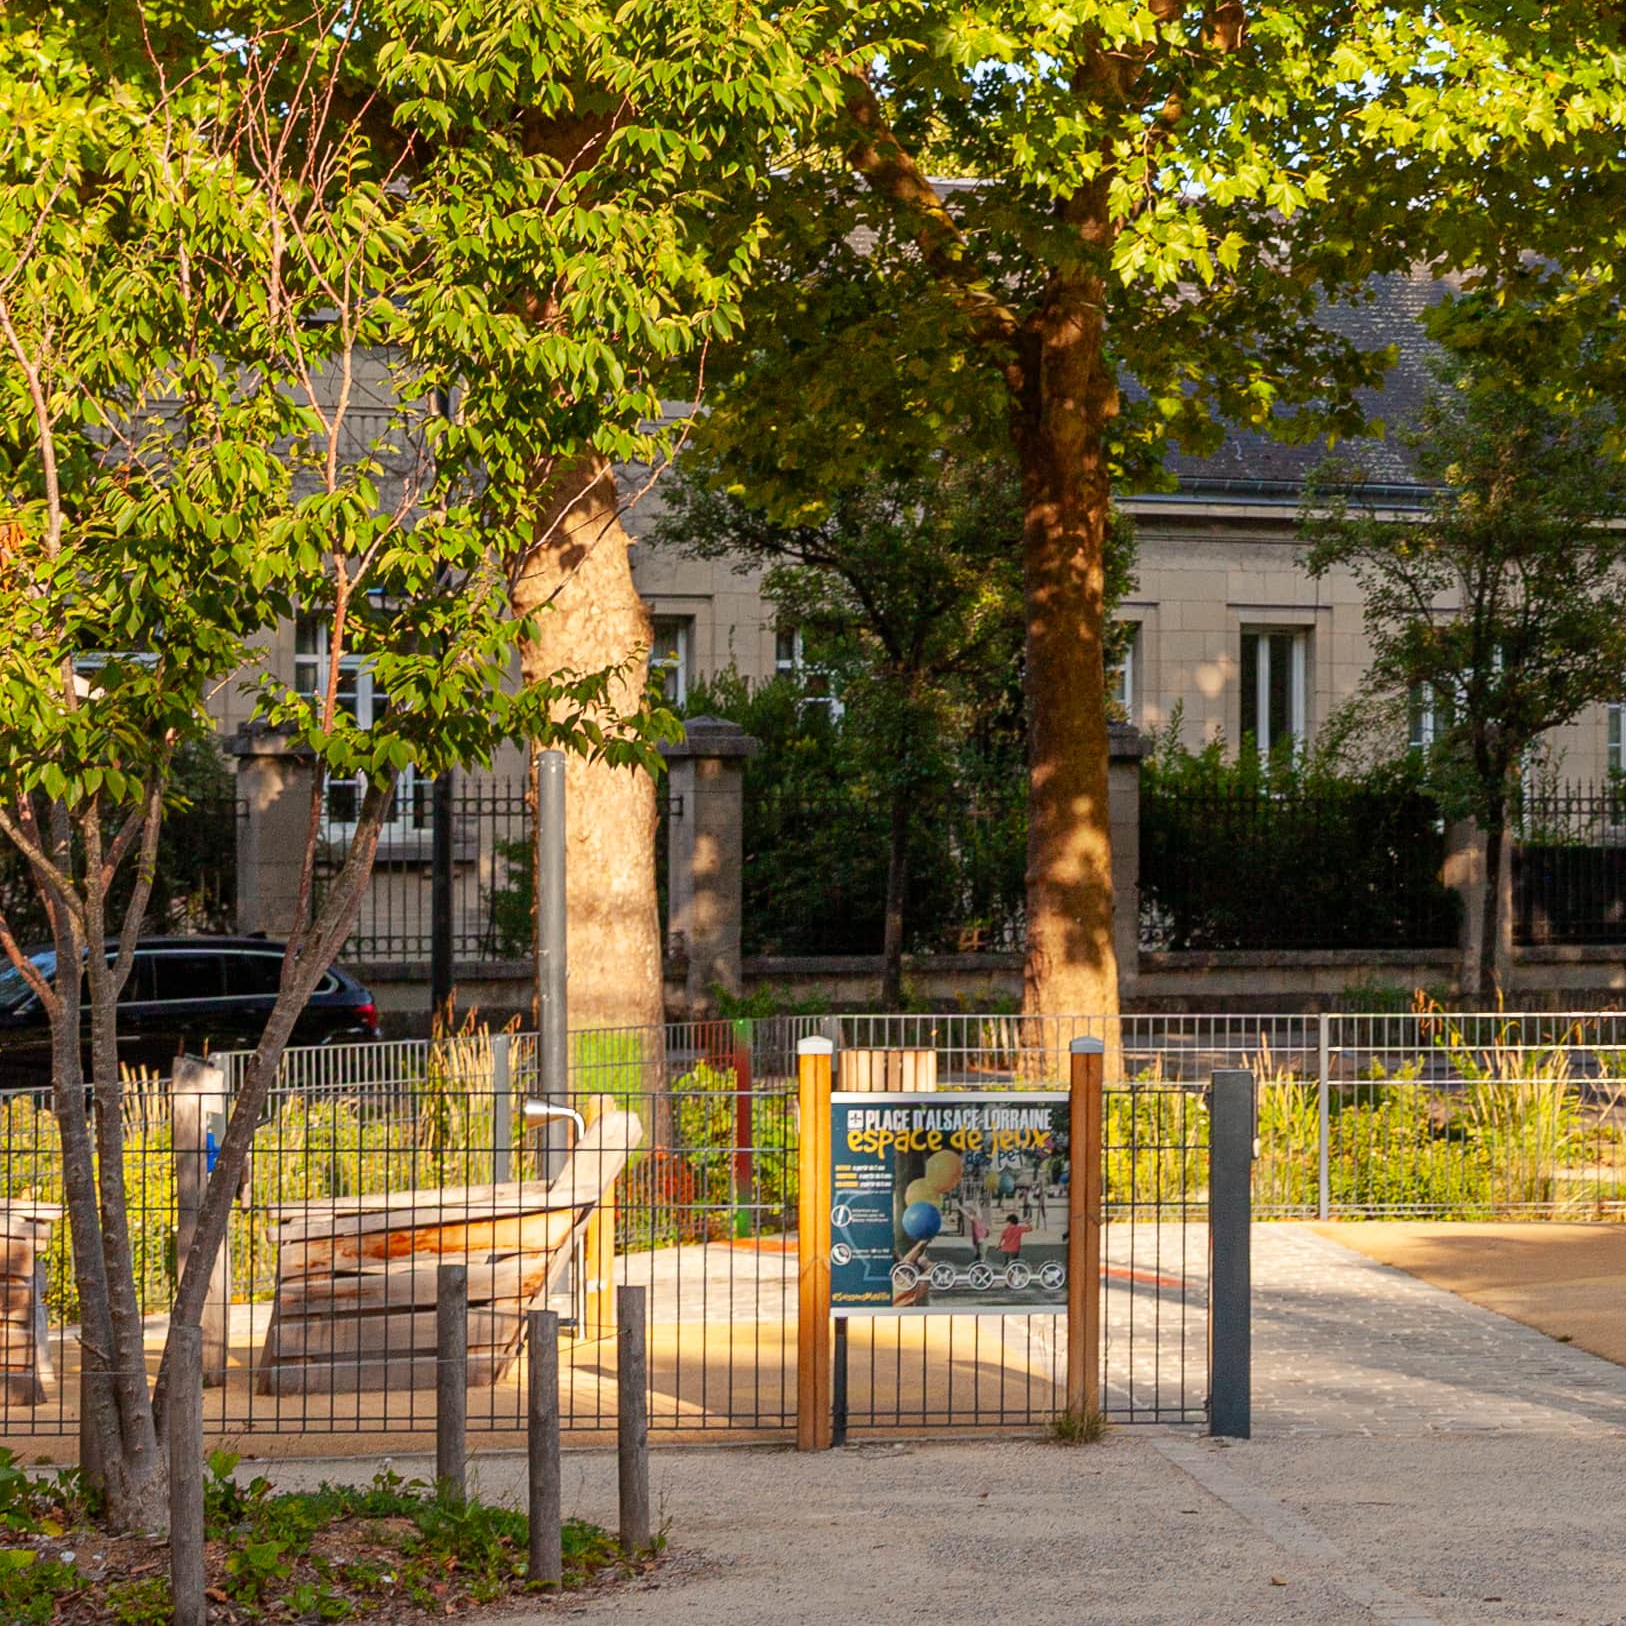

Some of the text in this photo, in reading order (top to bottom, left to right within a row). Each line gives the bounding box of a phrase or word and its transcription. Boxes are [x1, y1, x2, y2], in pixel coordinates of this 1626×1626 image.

[865, 1108, 1052, 1131] PLACE D'ALSACE-LORRAINE
[847, 1119, 1051, 1160] espace de jeux
